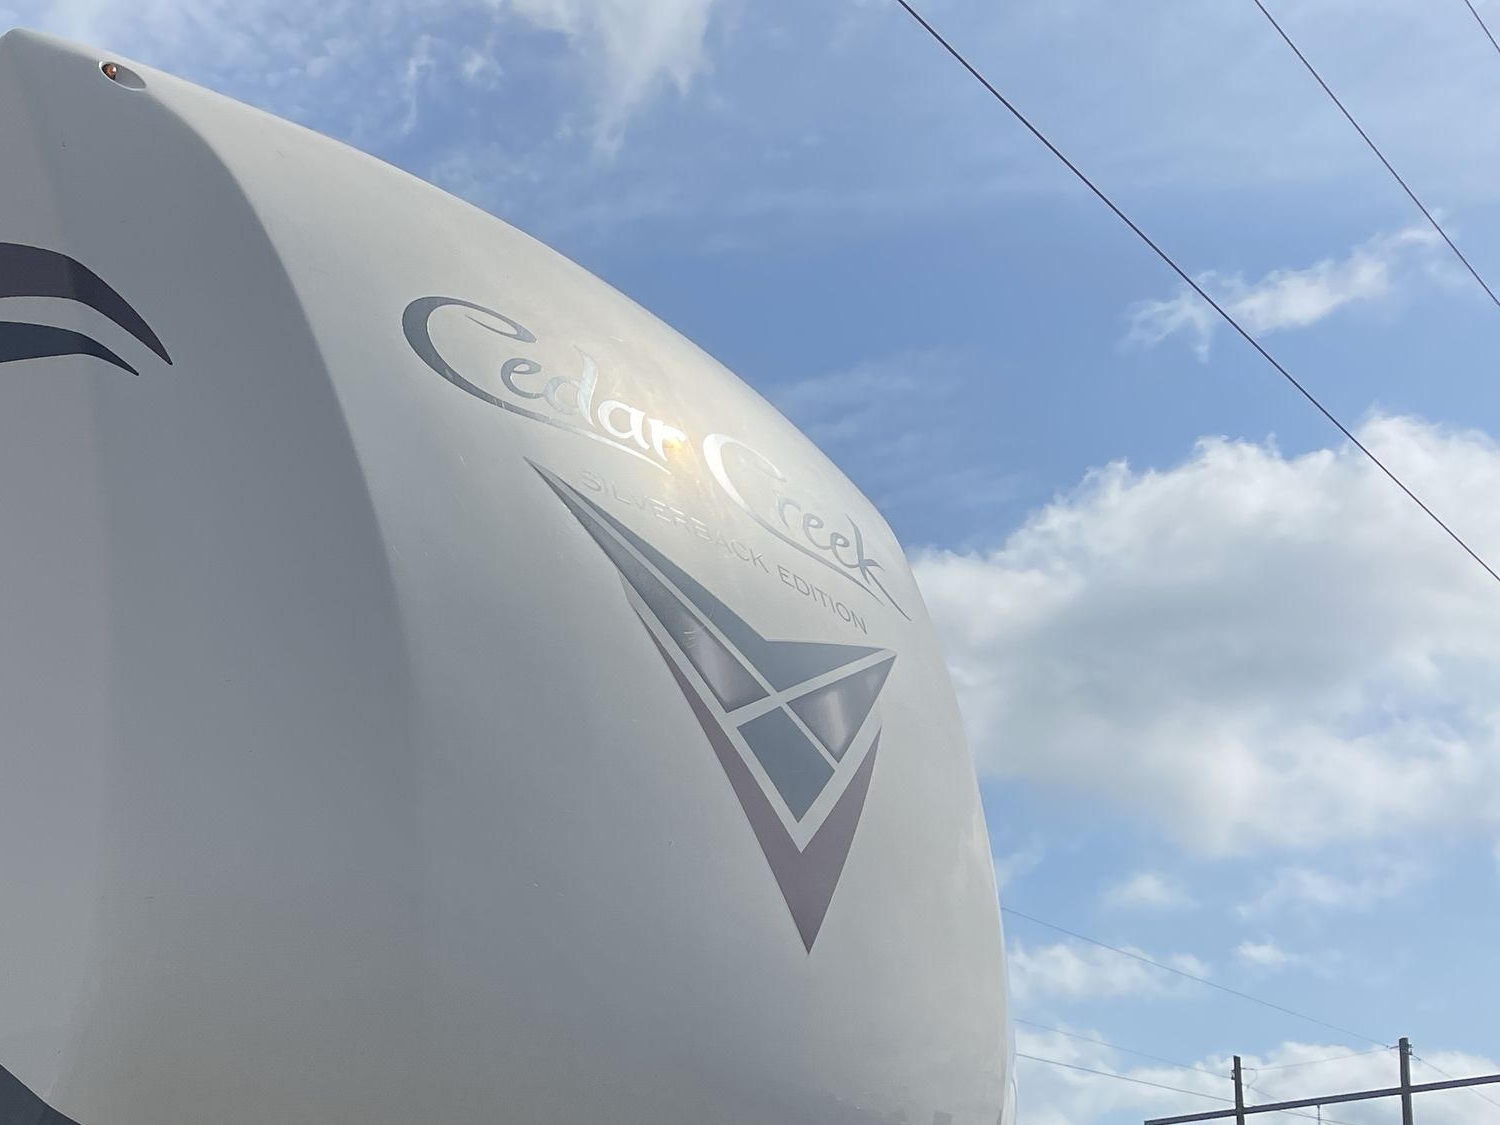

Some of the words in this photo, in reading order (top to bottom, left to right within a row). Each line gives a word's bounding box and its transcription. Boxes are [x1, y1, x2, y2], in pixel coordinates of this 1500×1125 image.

[402, 296, 687, 475] Cedar
[702, 433, 912, 621] Creek
[777, 564, 868, 635] EDITION
